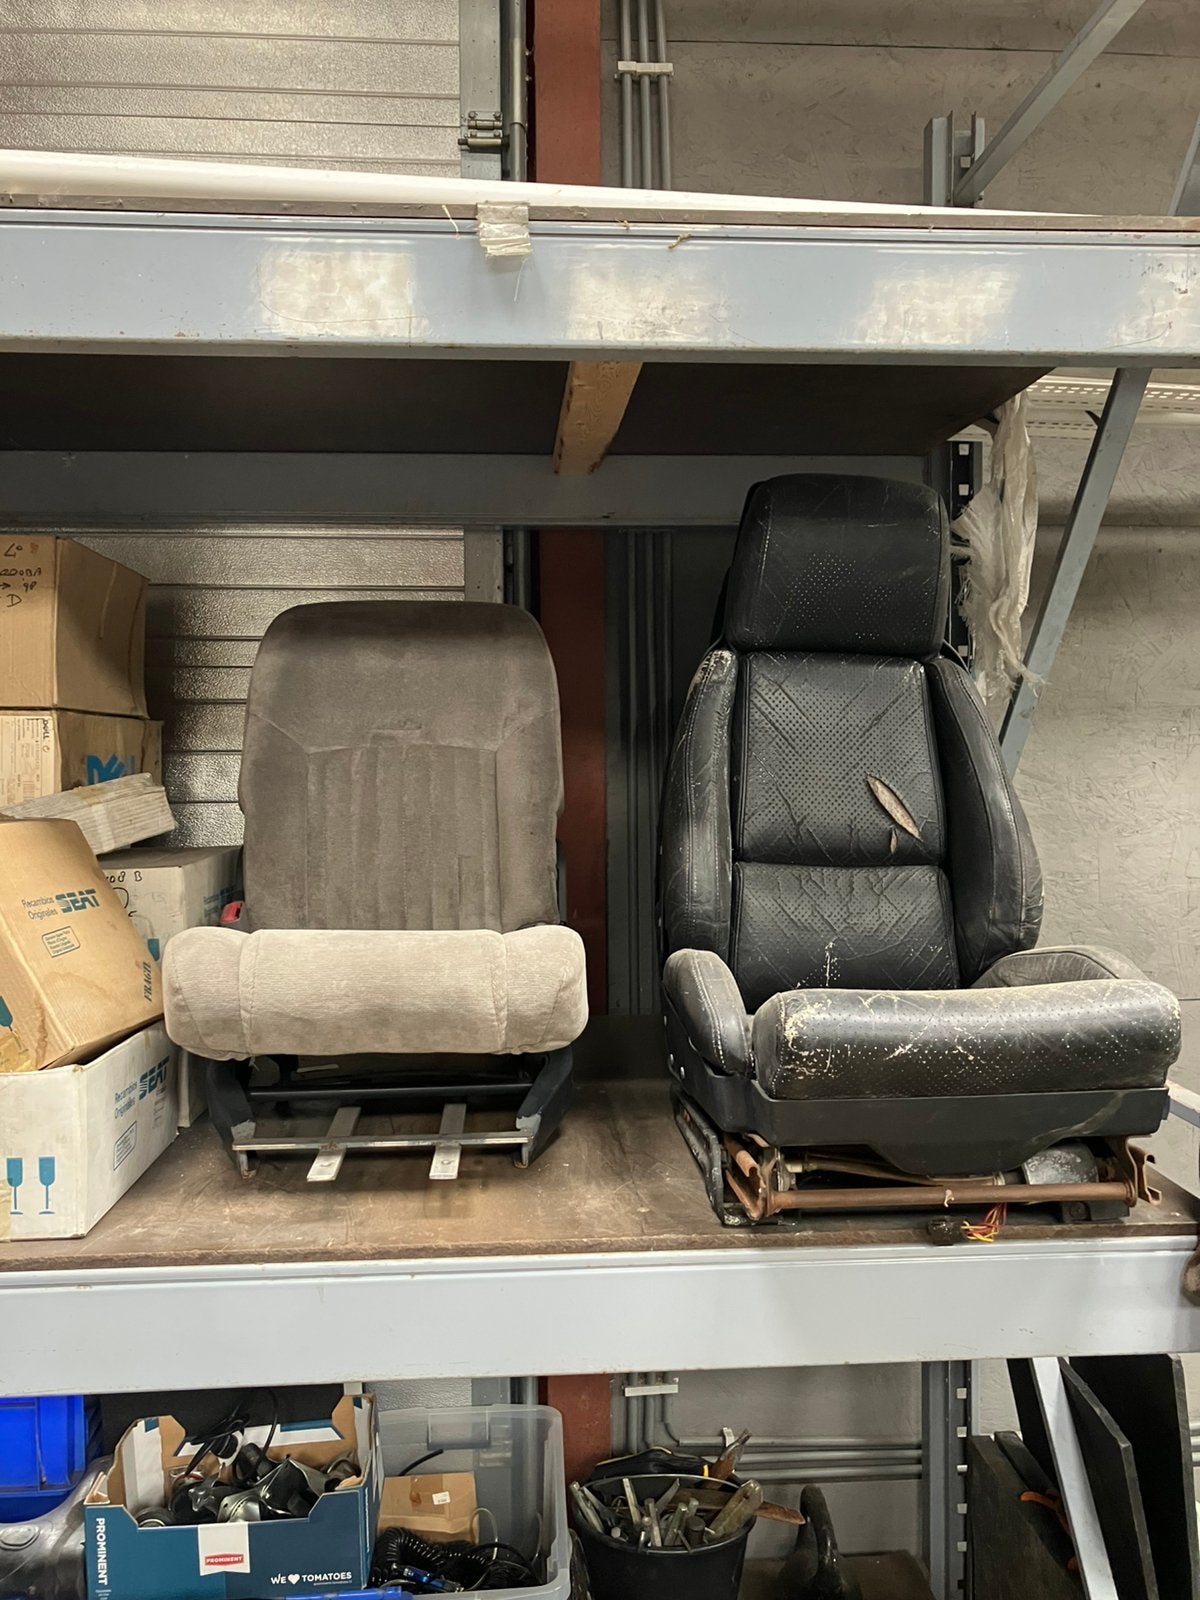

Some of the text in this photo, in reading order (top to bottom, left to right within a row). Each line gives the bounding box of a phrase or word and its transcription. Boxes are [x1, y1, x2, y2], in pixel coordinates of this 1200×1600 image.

[106, 871, 126, 884] 08
[21, 896, 54, 909] Recambios
[55, 888, 100, 913] SEAT
[28, 907, 58, 920] Originales
[139, 1055, 170, 1101] SEAT
[96, 1517, 108, 1586] PROMINENT
[206, 1556, 242, 1564] PROMINENT
[270, 1571, 353, 1585] WE TOMATOES
